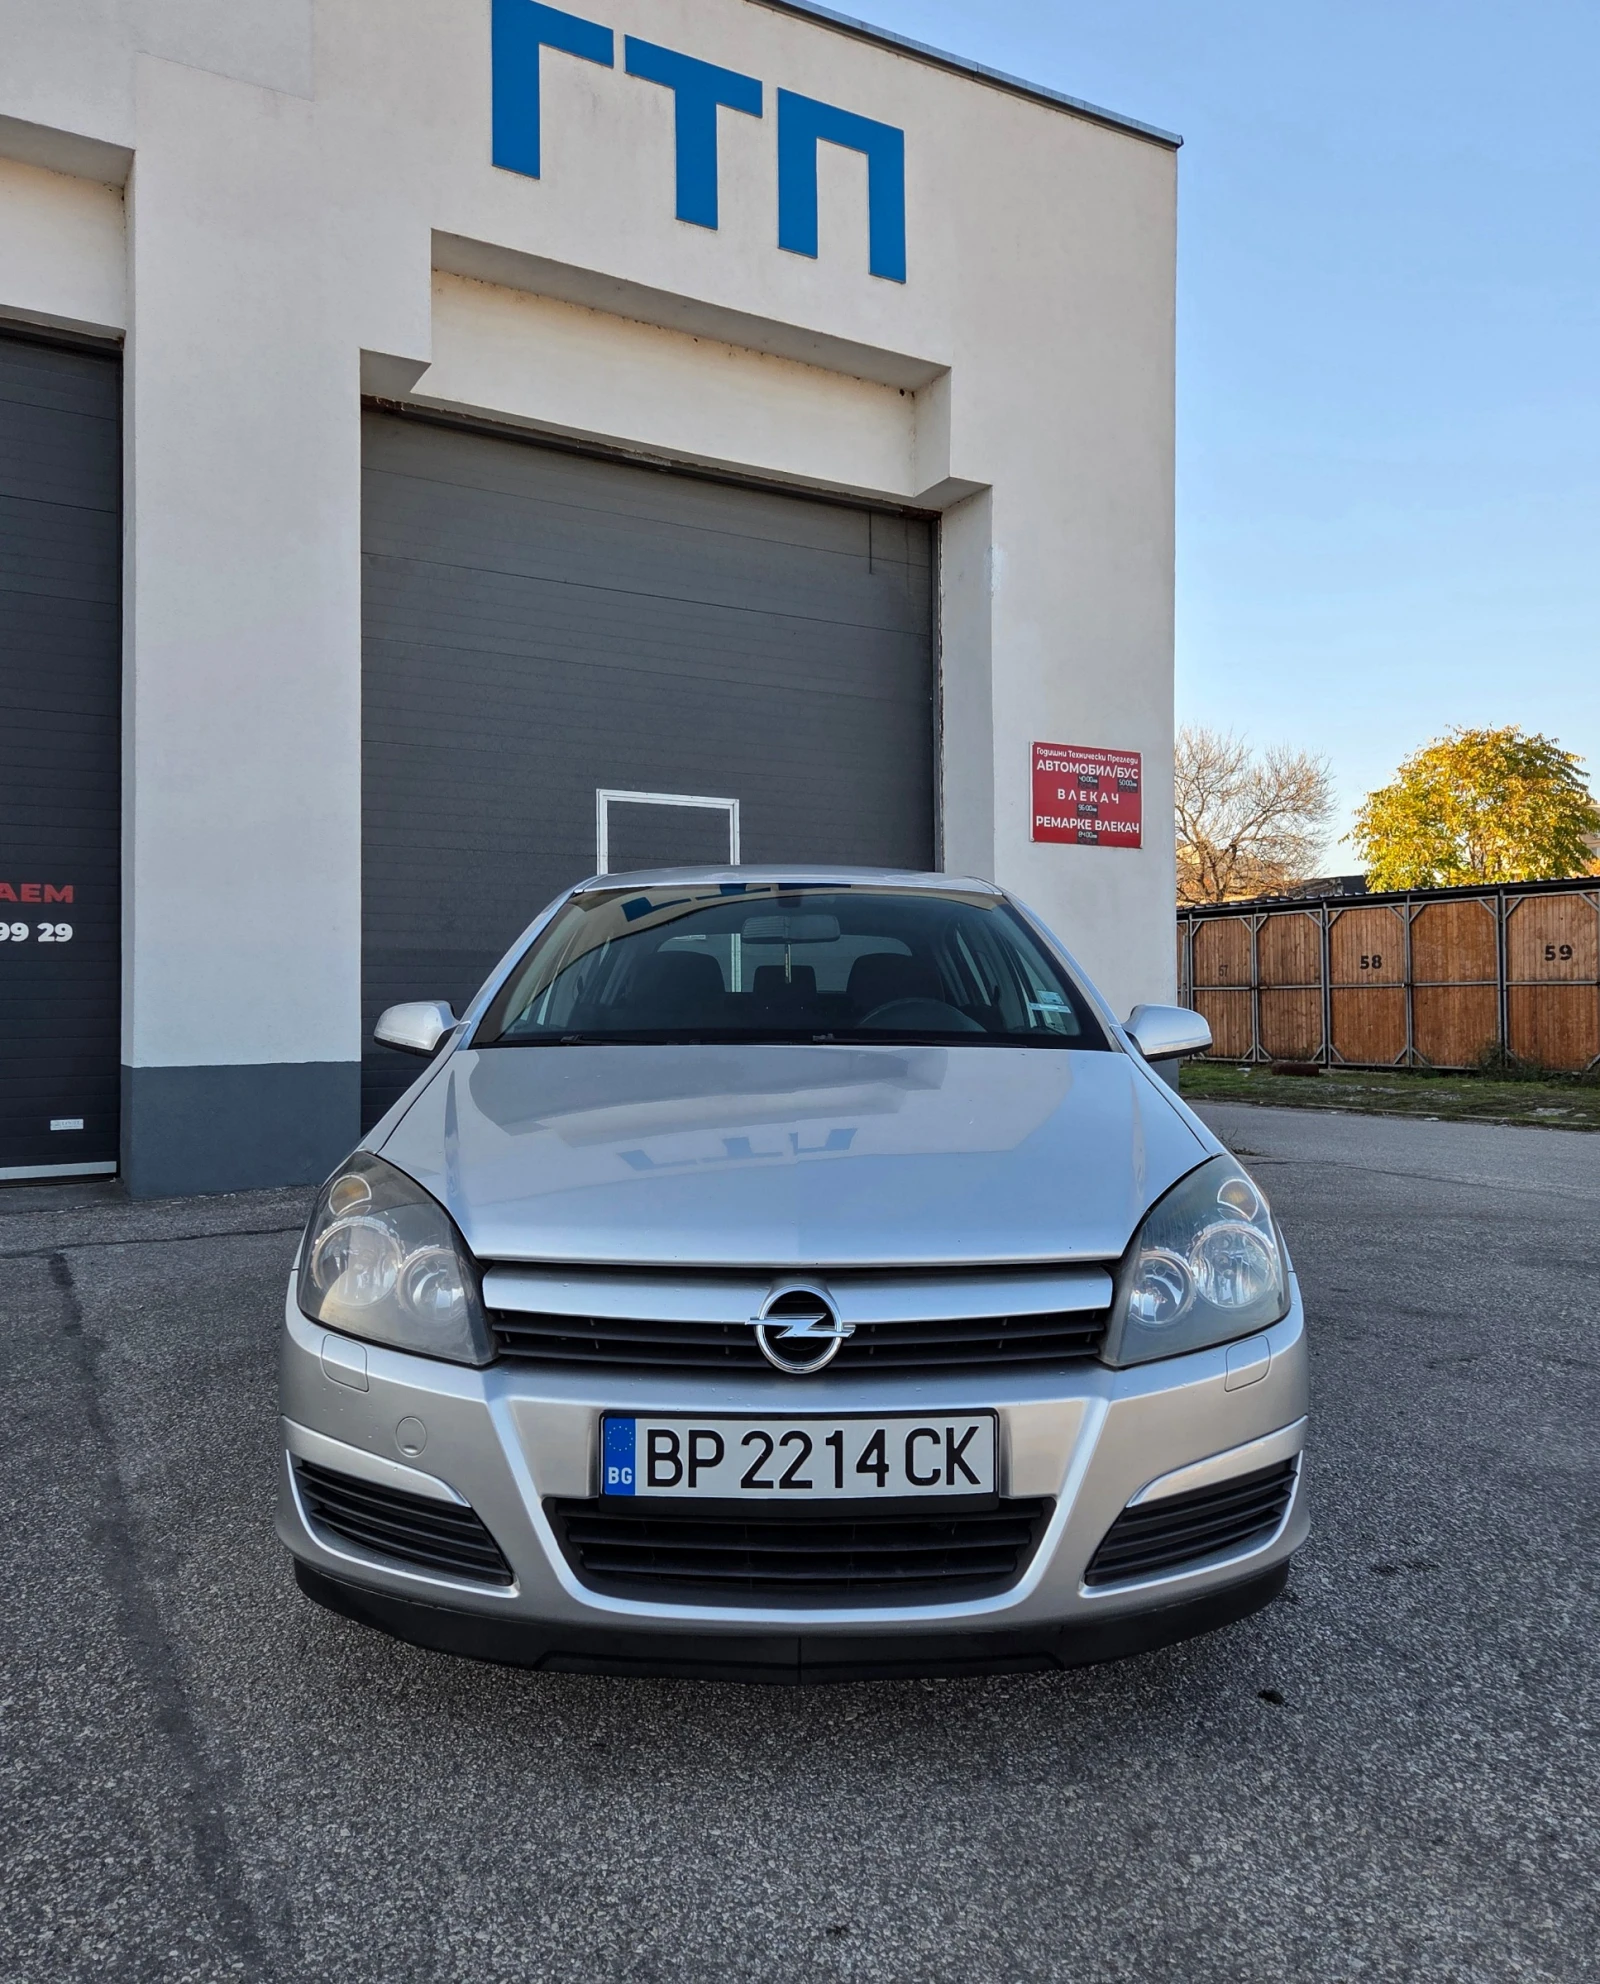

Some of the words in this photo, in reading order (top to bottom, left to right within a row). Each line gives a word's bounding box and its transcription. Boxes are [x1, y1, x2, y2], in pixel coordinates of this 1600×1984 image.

[491, 0, 906, 283] ГТП
[1036, 747, 1067, 758] Годишни
[1068, 750, 1106, 762] Технически
[1107, 754, 1139, 765] Прегледи
[1036, 759, 1139, 779] АВТОМОБИЛ/БУС
[1057, 789, 1120, 804] ВЛЕКАЧ
[1036, 815, 1092, 830] РЕМАРКЕ
[1095, 820, 1140, 834] ВЛЕКАЧ
[37, 922, 73, 943] 29
[1359, 954, 1383, 970] 58
[1544, 944, 1573, 961] 59
[1219, 965, 1228, 977] 57
[646, 1428, 725, 1488] BP
[740, 1428, 890, 1489] 2214
[904, 1425, 982, 1486] CK
[608, 1466, 633, 1485] BG
